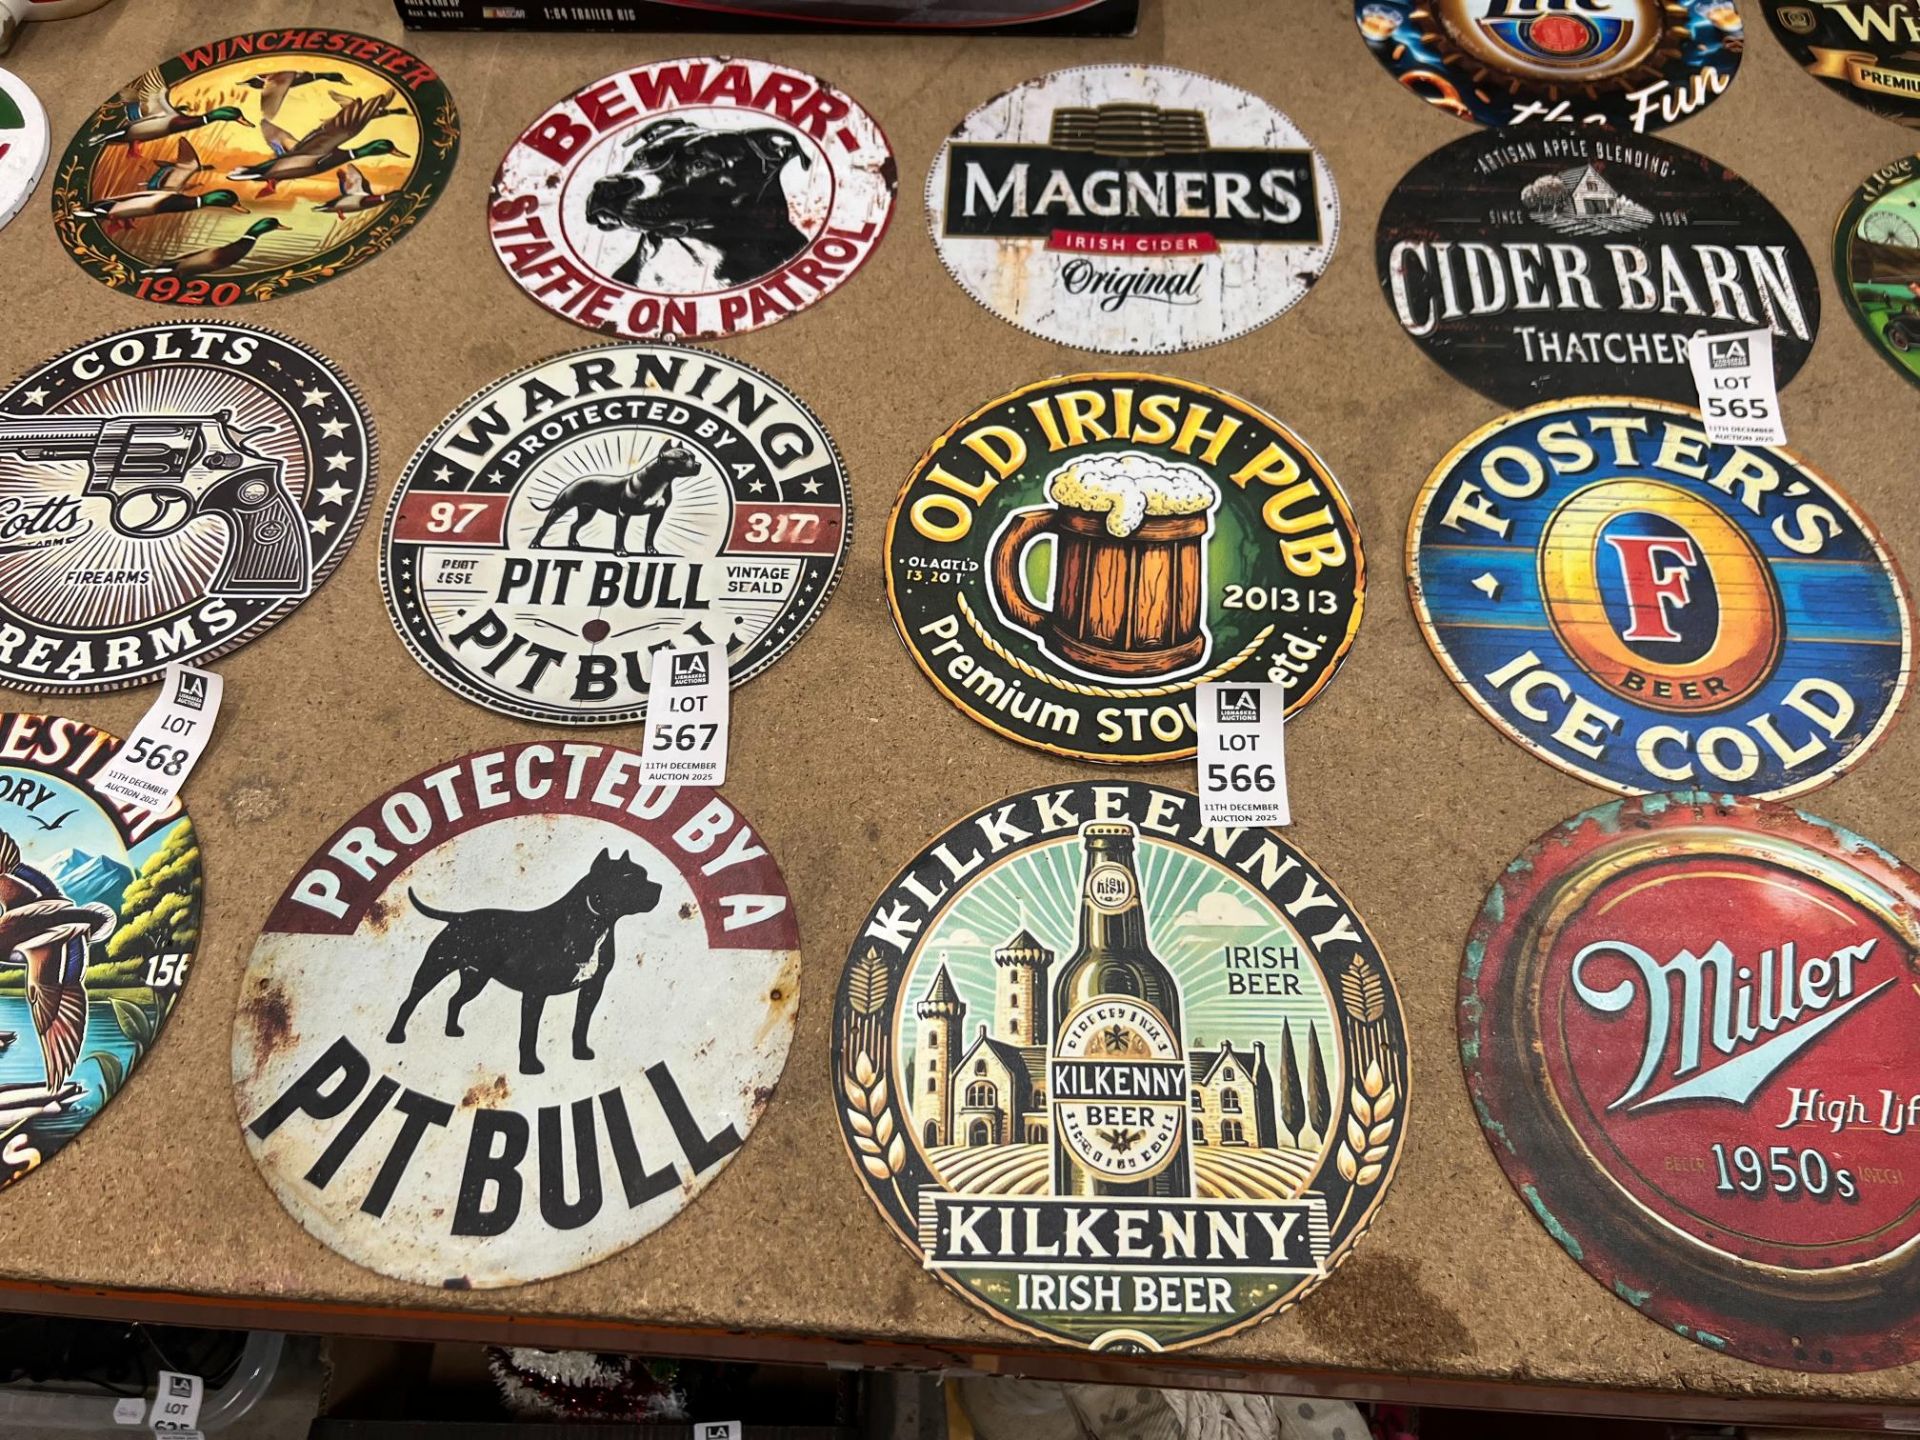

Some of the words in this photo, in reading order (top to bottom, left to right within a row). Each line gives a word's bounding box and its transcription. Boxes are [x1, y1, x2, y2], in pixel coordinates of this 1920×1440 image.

[571, 8, 614, 21] TRAILER
[617, 9, 636, 21] RIG
[1625, 66, 1730, 134] Fun
[1476, 141, 1538, 175] ARTISAN
[1543, 140, 1589, 158] APPLE
[1596, 141, 1670, 178] BLENDING
[962, 160, 1303, 224] MAGNERS
[1066, 234, 1126, 251] IRISH
[1136, 237, 1199, 252] CIDER
[493, 194, 616, 325] STAFFIE
[628, 299, 697, 336] ON
[719, 222, 877, 332] PATROL
[135, 276, 241, 307] 1920
[1061, 258, 1204, 313] Original
[1388, 240, 1600, 338] CIDER
[1604, 243, 1812, 342] BARN
[71, 330, 260, 381] COLTS
[1711, 340, 1746, 358] LA
[1713, 375, 1752, 390] LOT
[444, 353, 816, 471] WARNING
[1708, 398, 1769, 419] 565
[500, 400, 692, 470] PROTECTED
[693, 419, 738, 450] BY
[731, 462, 757, 481] A
[909, 425, 1028, 544] OLD
[1028, 388, 1244, 466] IRISH
[1228, 441, 1347, 577] PUB
[1439, 415, 1844, 556] FOSTER'S
[425, 502, 489, 534] 97
[63, 570, 151, 585] FIREARMS
[495, 557, 582, 606] PIT
[584, 561, 711, 609] BULL
[726, 565, 791, 580] VINTAGE
[1606, 534, 1698, 643] F
[448, 608, 567, 693] PIT
[675, 655, 706, 675] LA
[180, 671, 204, 698] LA
[919, 614, 1080, 735] Premium
[1619, 670, 1732, 699] BEER
[669, 695, 708, 713] LOT
[1220, 691, 1257, 710] LA
[1484, 650, 1621, 760] ICE
[1636, 677, 1857, 782] COLD
[161, 714, 197, 736] LOT
[652, 723, 718, 751] 567
[125, 736, 189, 777] 568
[1219, 734, 1260, 751] LOT
[645, 762, 668, 770] 11TH
[669, 762, 717, 770] DECEMBER
[648, 773, 690, 781] AUCTION
[691, 773, 713, 781] 2025
[1207, 763, 1276, 793] 566
[104, 782, 141, 799] AUCTION
[139, 793, 160, 806] 2025
[108, 770, 129, 783] 11TH
[129, 777, 169, 796] DECEMBER
[1204, 803, 1228, 811] 11TH
[1229, 803, 1279, 811] DECEMBER
[1210, 814, 1253, 822] AUCTION
[290, 744, 683, 919] PROTECTED
[672, 797, 768, 877] BY
[717, 892, 787, 932] A
[1224, 945, 1300, 970] IRISH
[1227, 973, 1302, 996] BEER
[1571, 937, 1898, 1112] Miller
[1055, 1064, 1186, 1097] KILKENNY
[1086, 1105, 1155, 1127] BEER
[1774, 1086, 1874, 1134] High
[248, 1035, 456, 1219] PIT
[450, 1060, 744, 1237] BULL
[1711, 1142, 1856, 1198] 1950s
[947, 1206, 1300, 1261] KILKENNY
[1016, 1273, 1122, 1312] IRISH
[1132, 1275, 1236, 1314] BEER
[165, 1402, 189, 1415] LOT
[708, 1427, 727, 1438] LA
